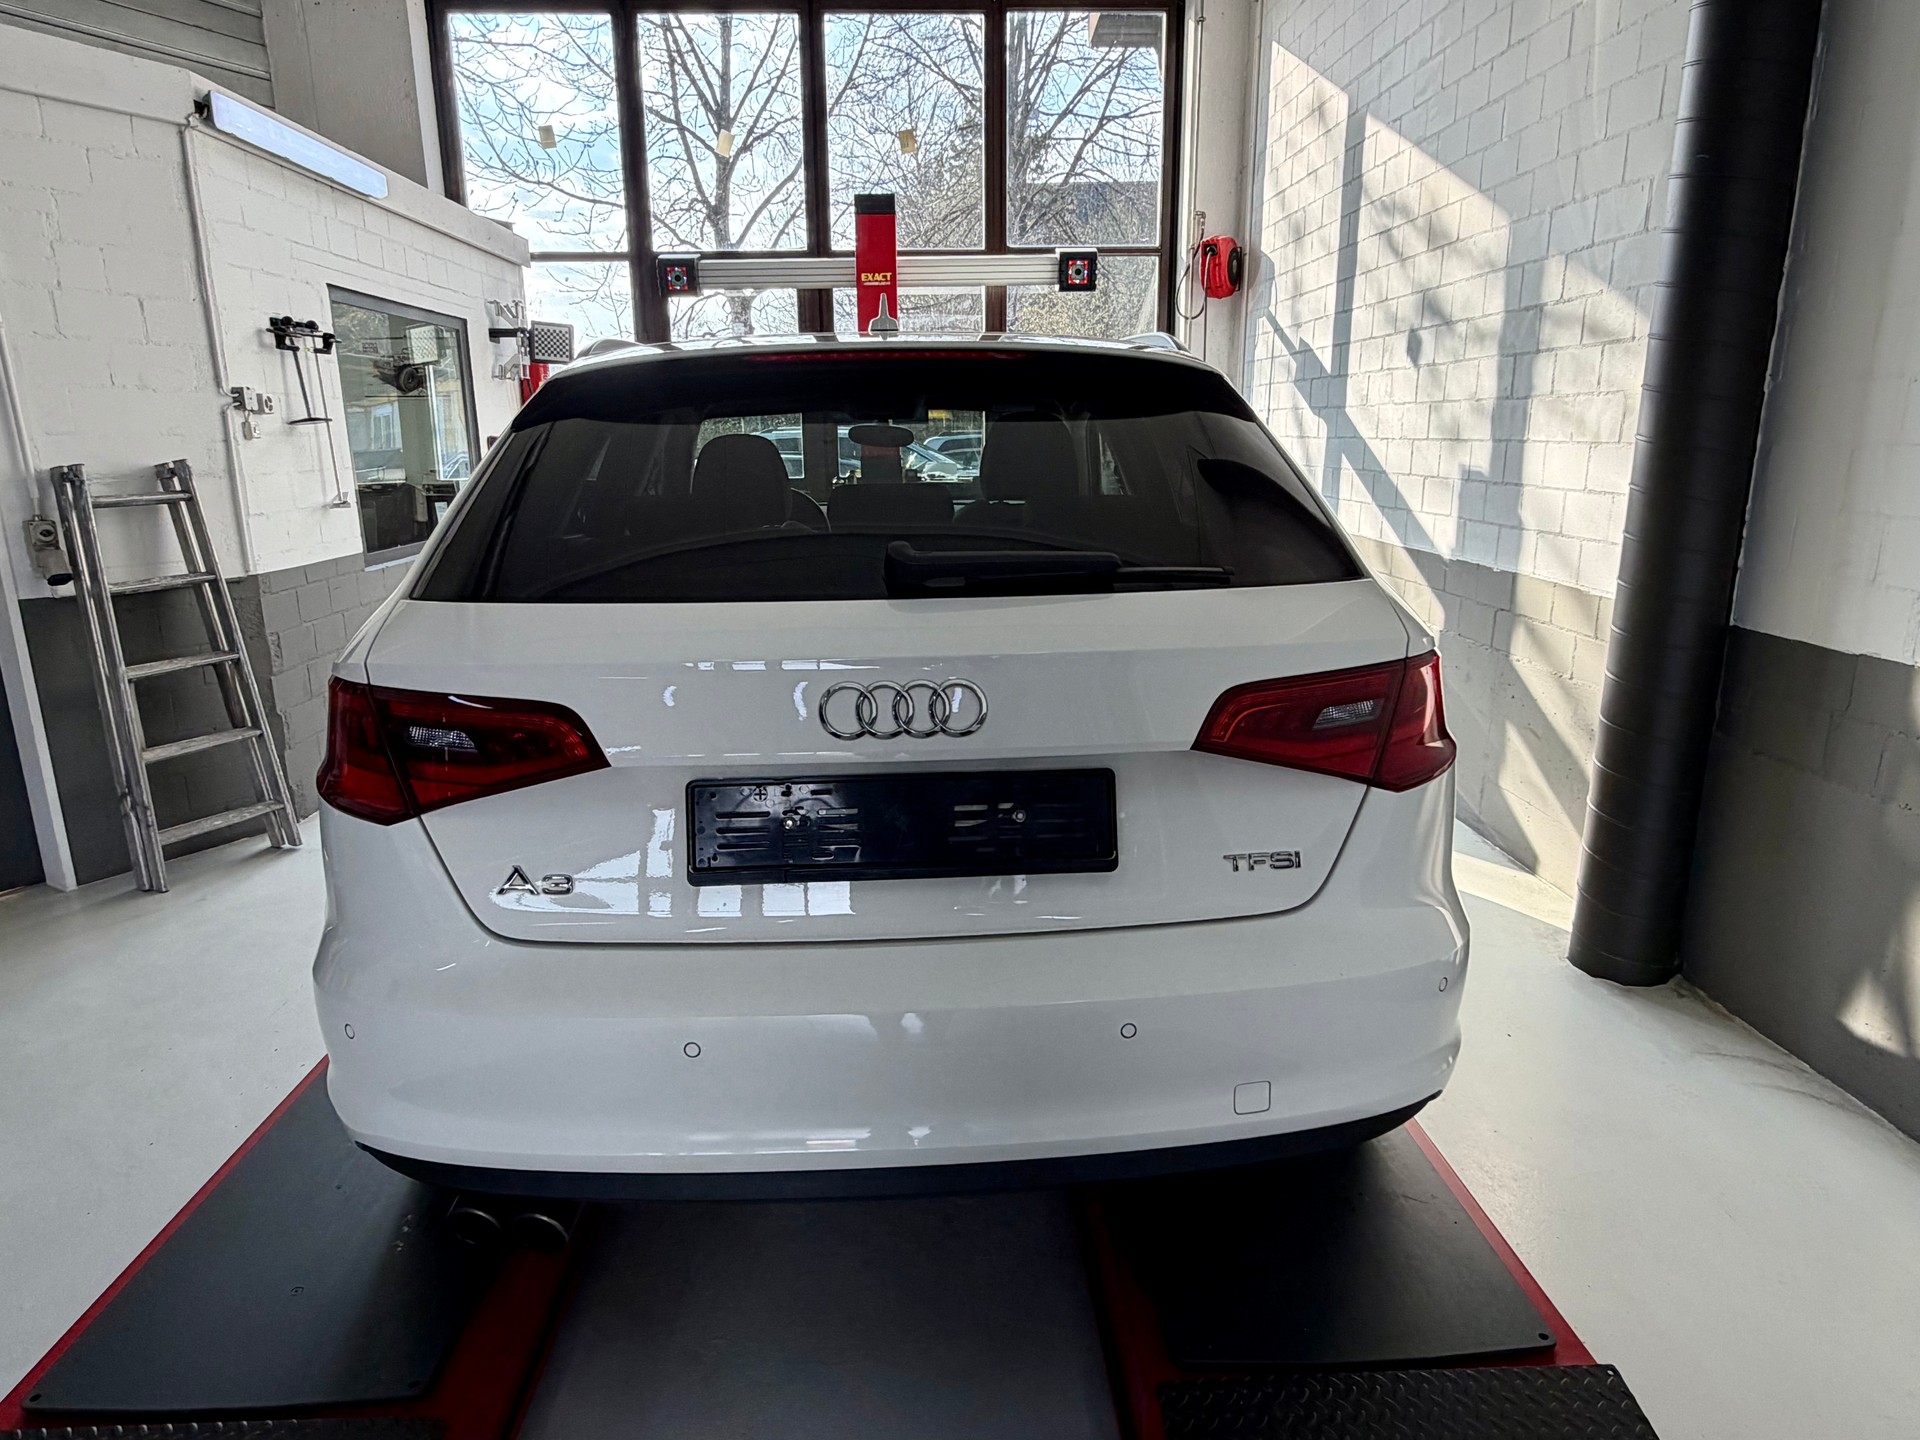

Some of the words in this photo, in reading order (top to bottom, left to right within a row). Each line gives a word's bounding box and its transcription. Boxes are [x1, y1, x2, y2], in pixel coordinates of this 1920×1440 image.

[861, 272, 892, 282] EXACT
[1223, 850, 1301, 872] TFSI
[496, 865, 574, 895] A3
